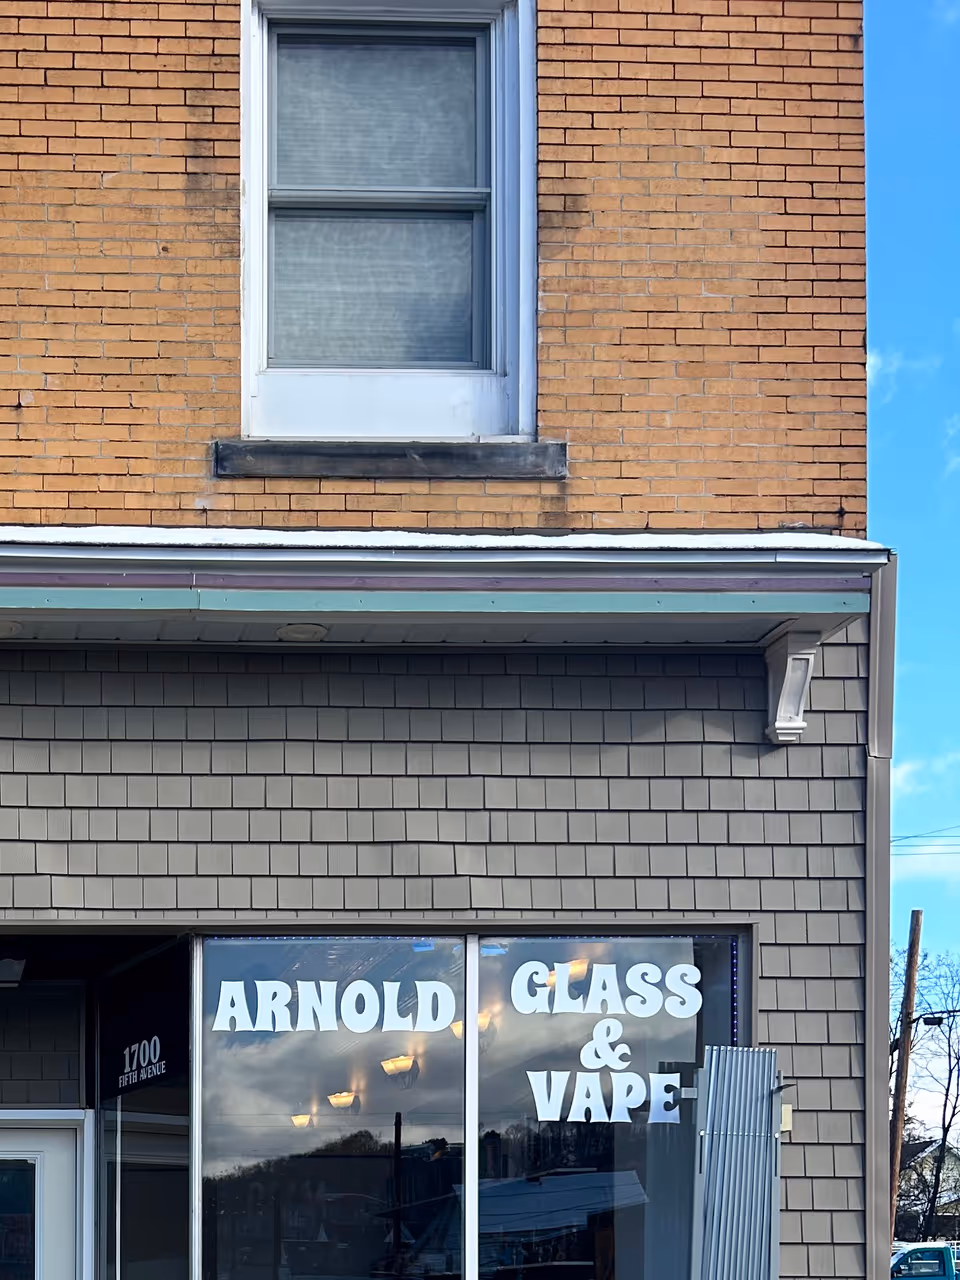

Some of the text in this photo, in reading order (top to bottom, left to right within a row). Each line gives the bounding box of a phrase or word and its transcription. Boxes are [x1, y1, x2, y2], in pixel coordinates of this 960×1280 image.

[212, 980, 457, 1034] ARNOLD
[510, 960, 703, 1019] GLASS
[123, 1035, 160, 1073] 1700
[580, 1018, 632, 1070] &
[118, 1060, 166, 1088] FIFTH AVENUE
[526, 1071, 681, 1124] VAPE
